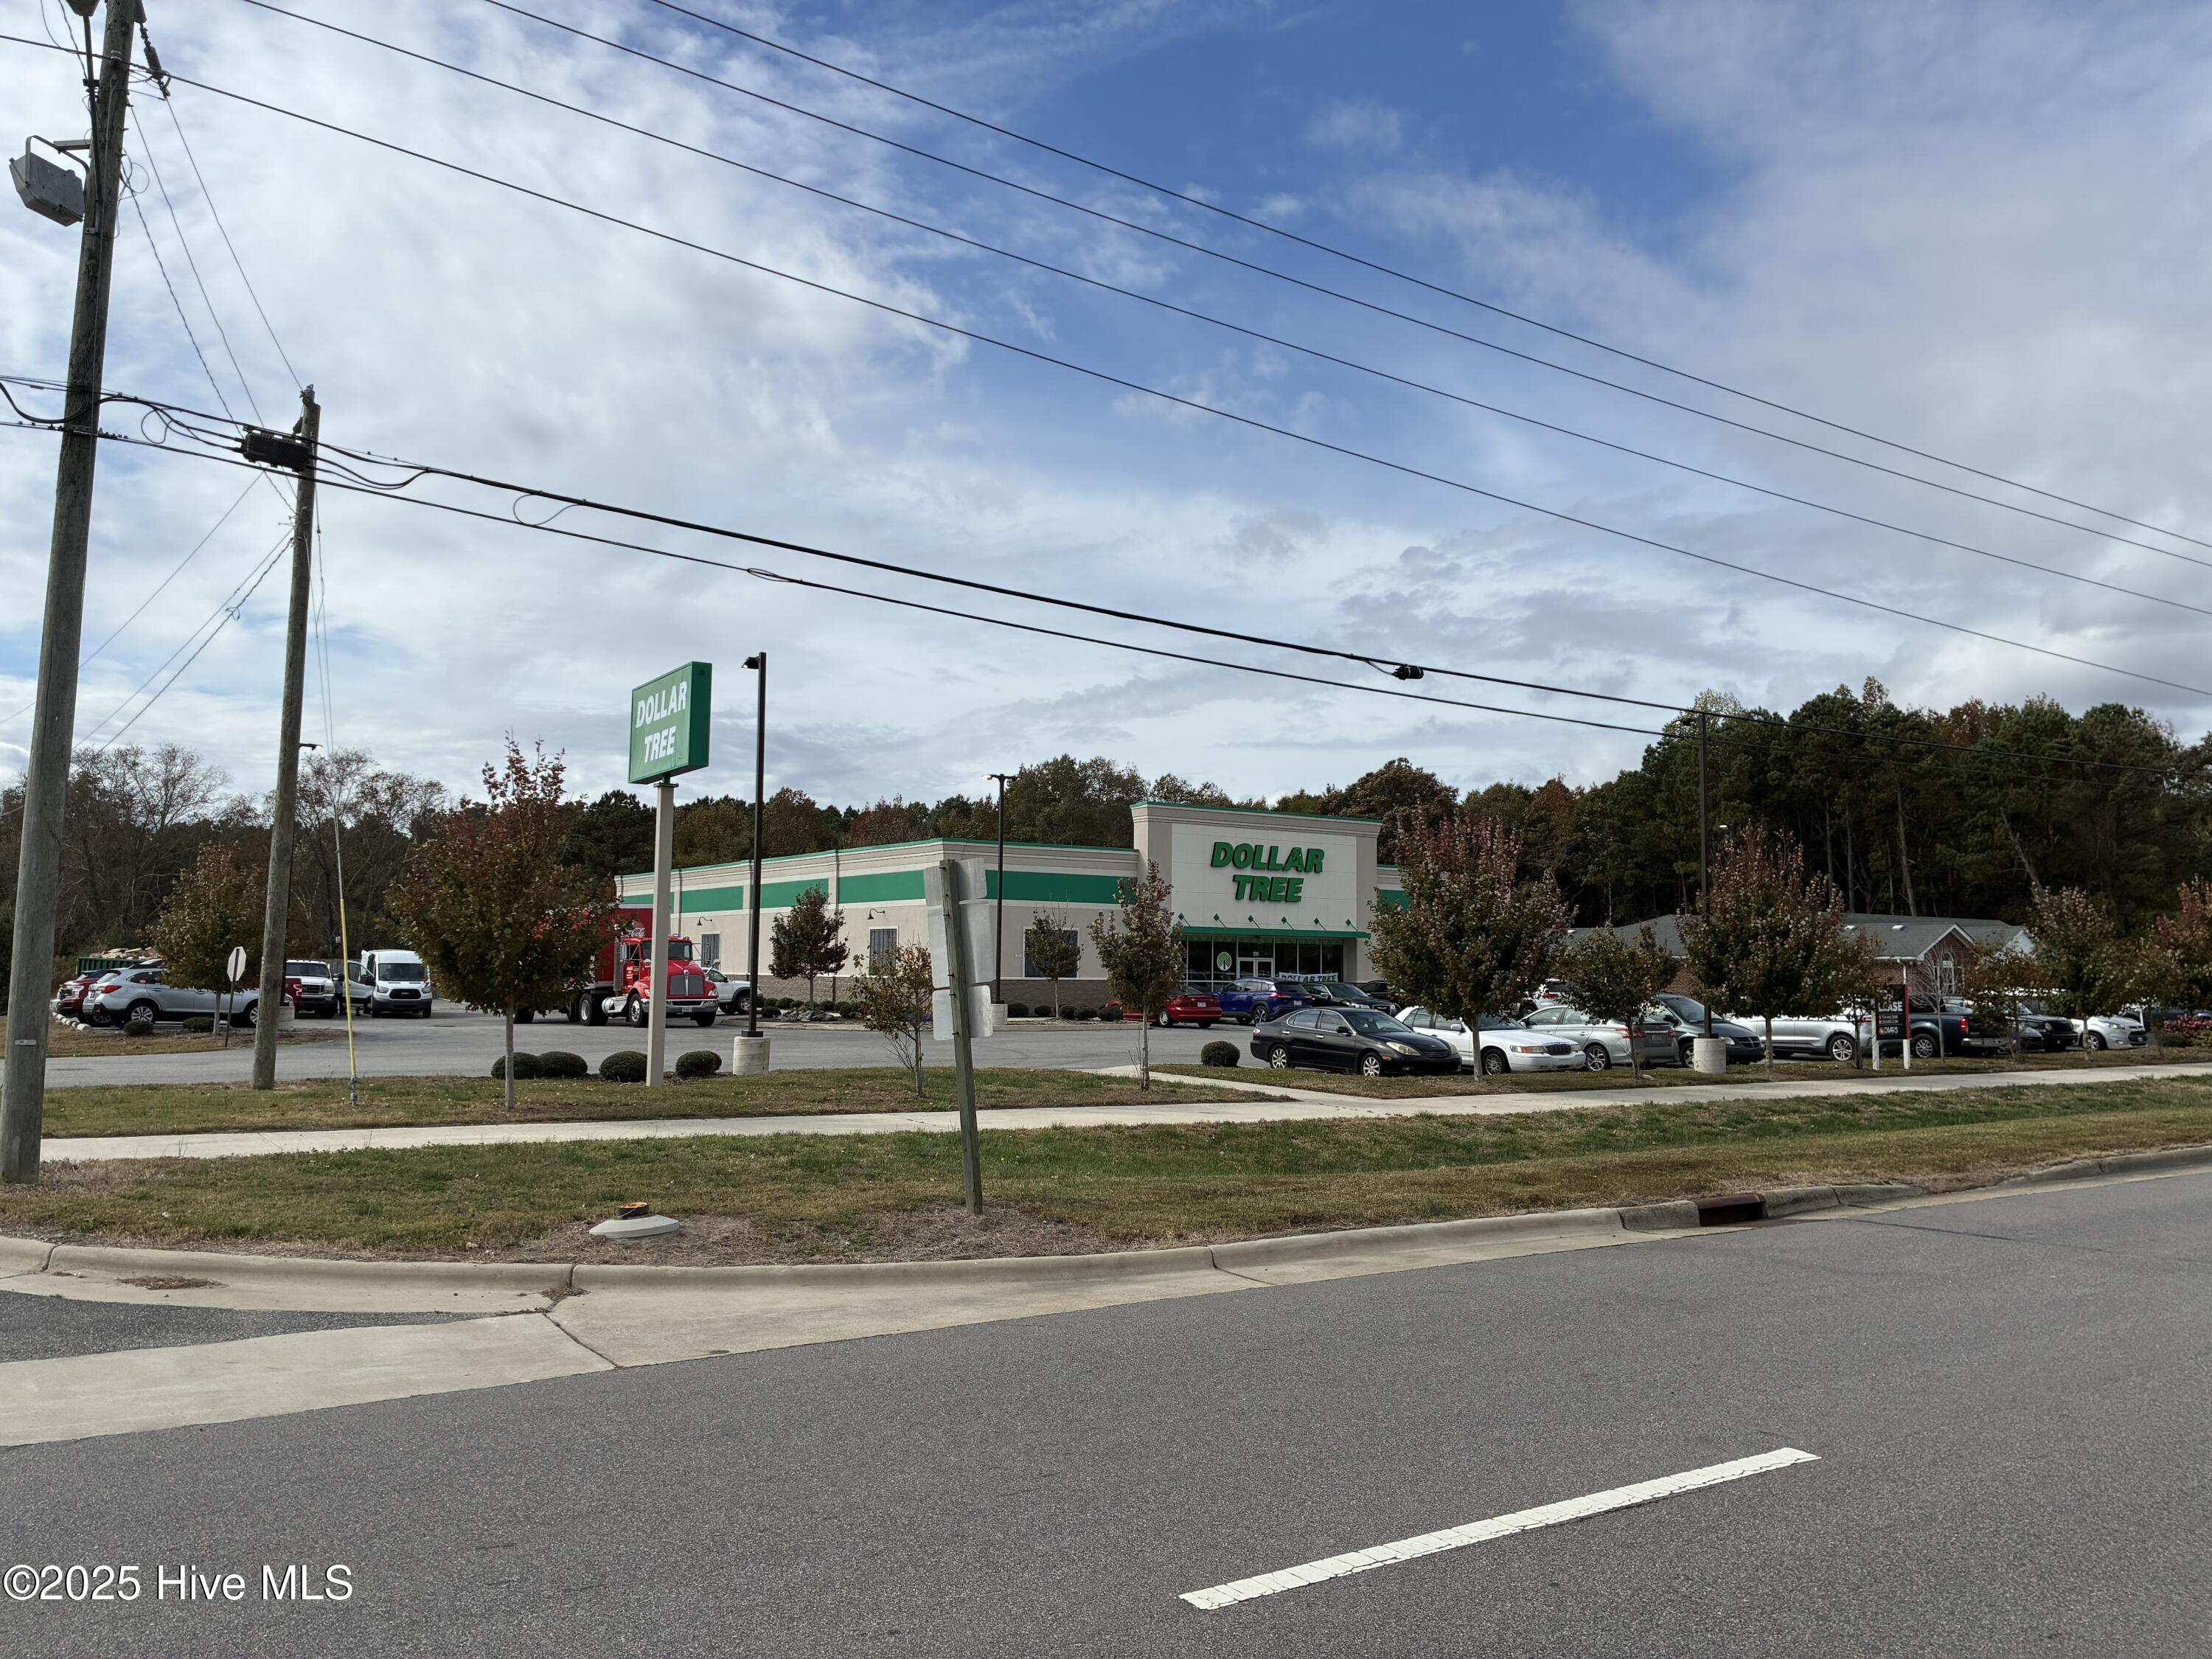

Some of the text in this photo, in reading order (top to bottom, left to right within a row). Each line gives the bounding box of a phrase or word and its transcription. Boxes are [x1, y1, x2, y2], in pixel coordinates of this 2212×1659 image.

[636, 681, 687, 728] DOLLAR
[644, 726, 676, 763] TREE
[1211, 841, 1325, 873] DOLLAR
[1233, 874, 1304, 902] TREE
[1318, 974, 1336, 982] TREE
